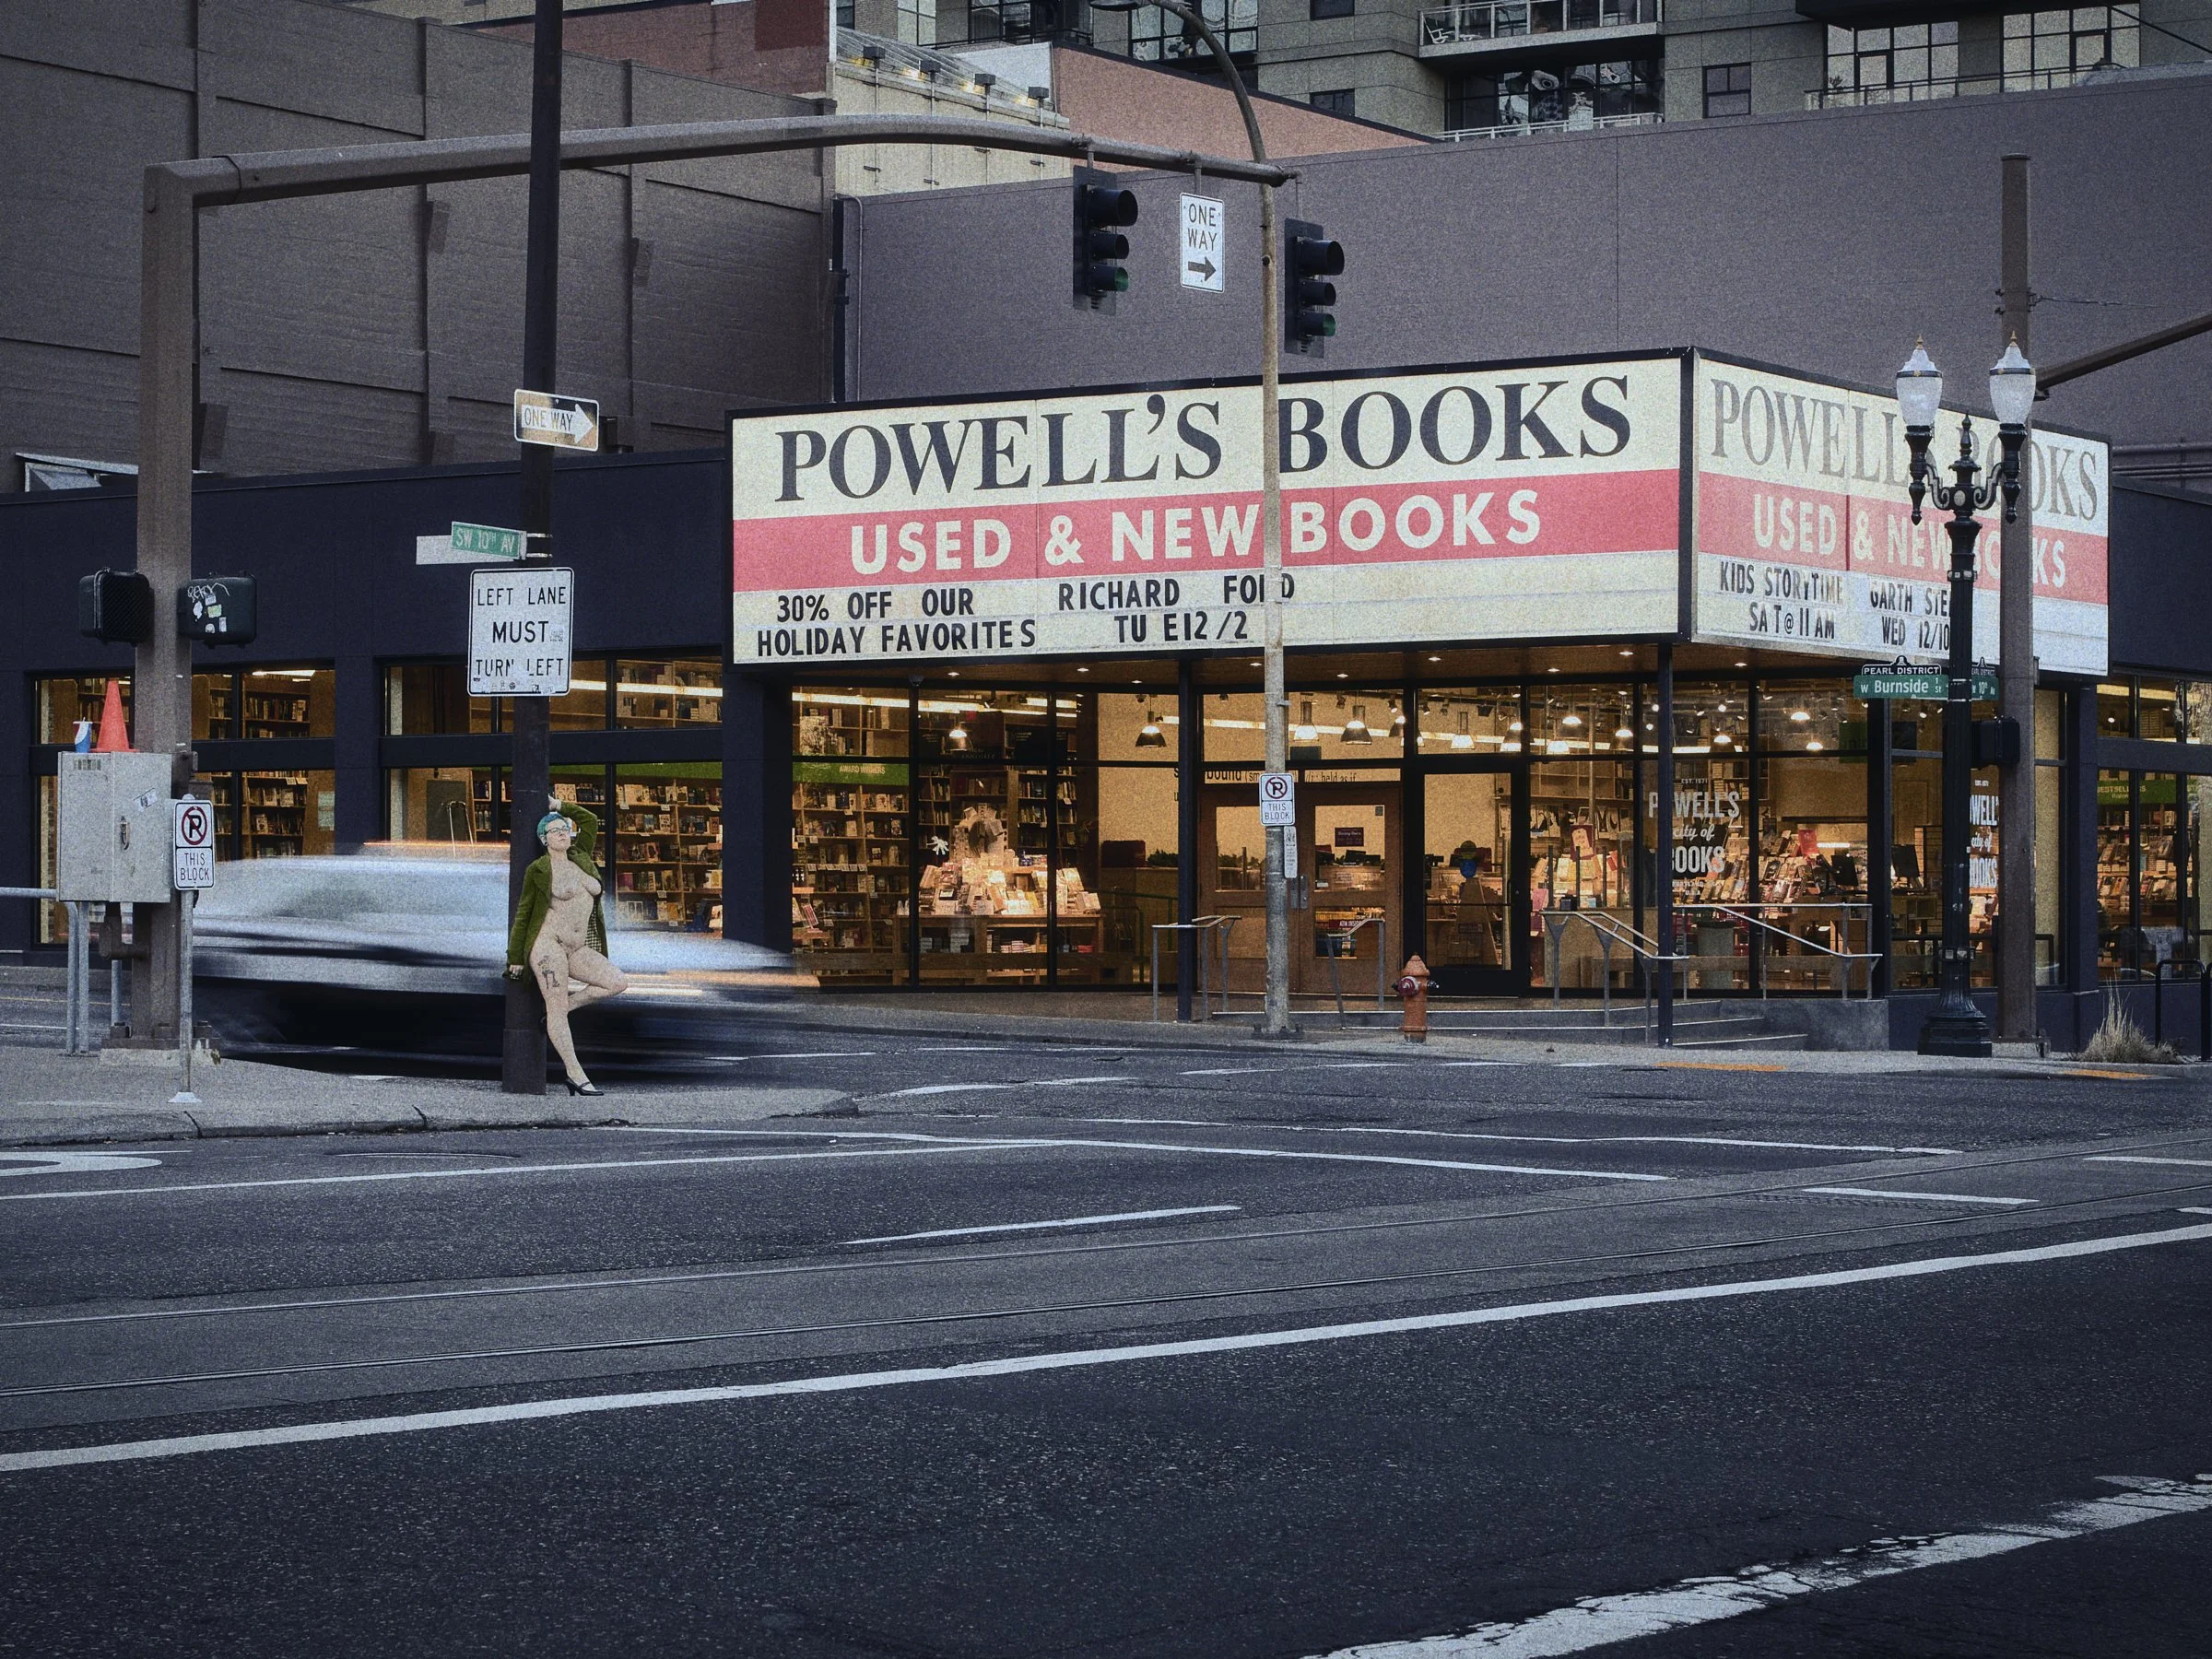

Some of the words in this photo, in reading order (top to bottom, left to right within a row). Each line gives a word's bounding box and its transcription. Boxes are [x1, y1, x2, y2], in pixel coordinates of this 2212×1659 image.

[1188, 203, 1217, 227] ONE
[1187, 228, 1218, 252] WAY
[524, 407, 547, 428] ONE
[551, 411, 573, 431] WAY
[774, 394, 1222, 502] POWELL'S
[1278, 374, 1631, 474] BOOKS
[850, 518, 1012, 575] USED
[1044, 514, 1085, 566] &
[1112, 503, 1262, 562] NEW
[1290, 489, 1541, 554] BOOKS
[1753, 493, 1837, 555] USED
[1853, 512, 1875, 561] &
[455, 527, 473, 548] SW
[477, 529, 497, 550] 10TH
[500, 533, 515, 553] AV
[1057, 578, 1181, 611] RICHARD
[1223, 572, 1296, 604] FOD
[1720, 560, 1755, 594] KIDS
[1764, 566, 1843, 605] STORYTIME
[477, 587, 513, 606] LEFT
[528, 586, 567, 605] LANE
[777, 593, 830, 623] 30%
[847, 591, 893, 619] OFF
[922, 588, 974, 616] OUR
[1869, 580, 1913, 613] GARTH
[492, 620, 549, 643] MUST
[756, 626, 865, 658] HOLIDAY
[880, 618, 1037, 654] FAVORITES
[1881, 616, 1906, 646] WED
[476, 658, 514, 677] TURN
[527, 658, 564, 677] LEFT
[1864, 666, 1894, 675] PEARL
[1897, 666, 1939, 675] DISTRICT
[1860, 684, 1869, 693] W
[1874, 678, 1929, 694] Burnside
[840, 765, 860, 773] AWARD
[1265, 812, 1290, 820] BLOCK
[1268, 803, 1287, 812] THIS
[184, 853, 206, 866] THIS
[1672, 845, 1726, 873] OOKS
[180, 867, 210, 881] BLOCK
